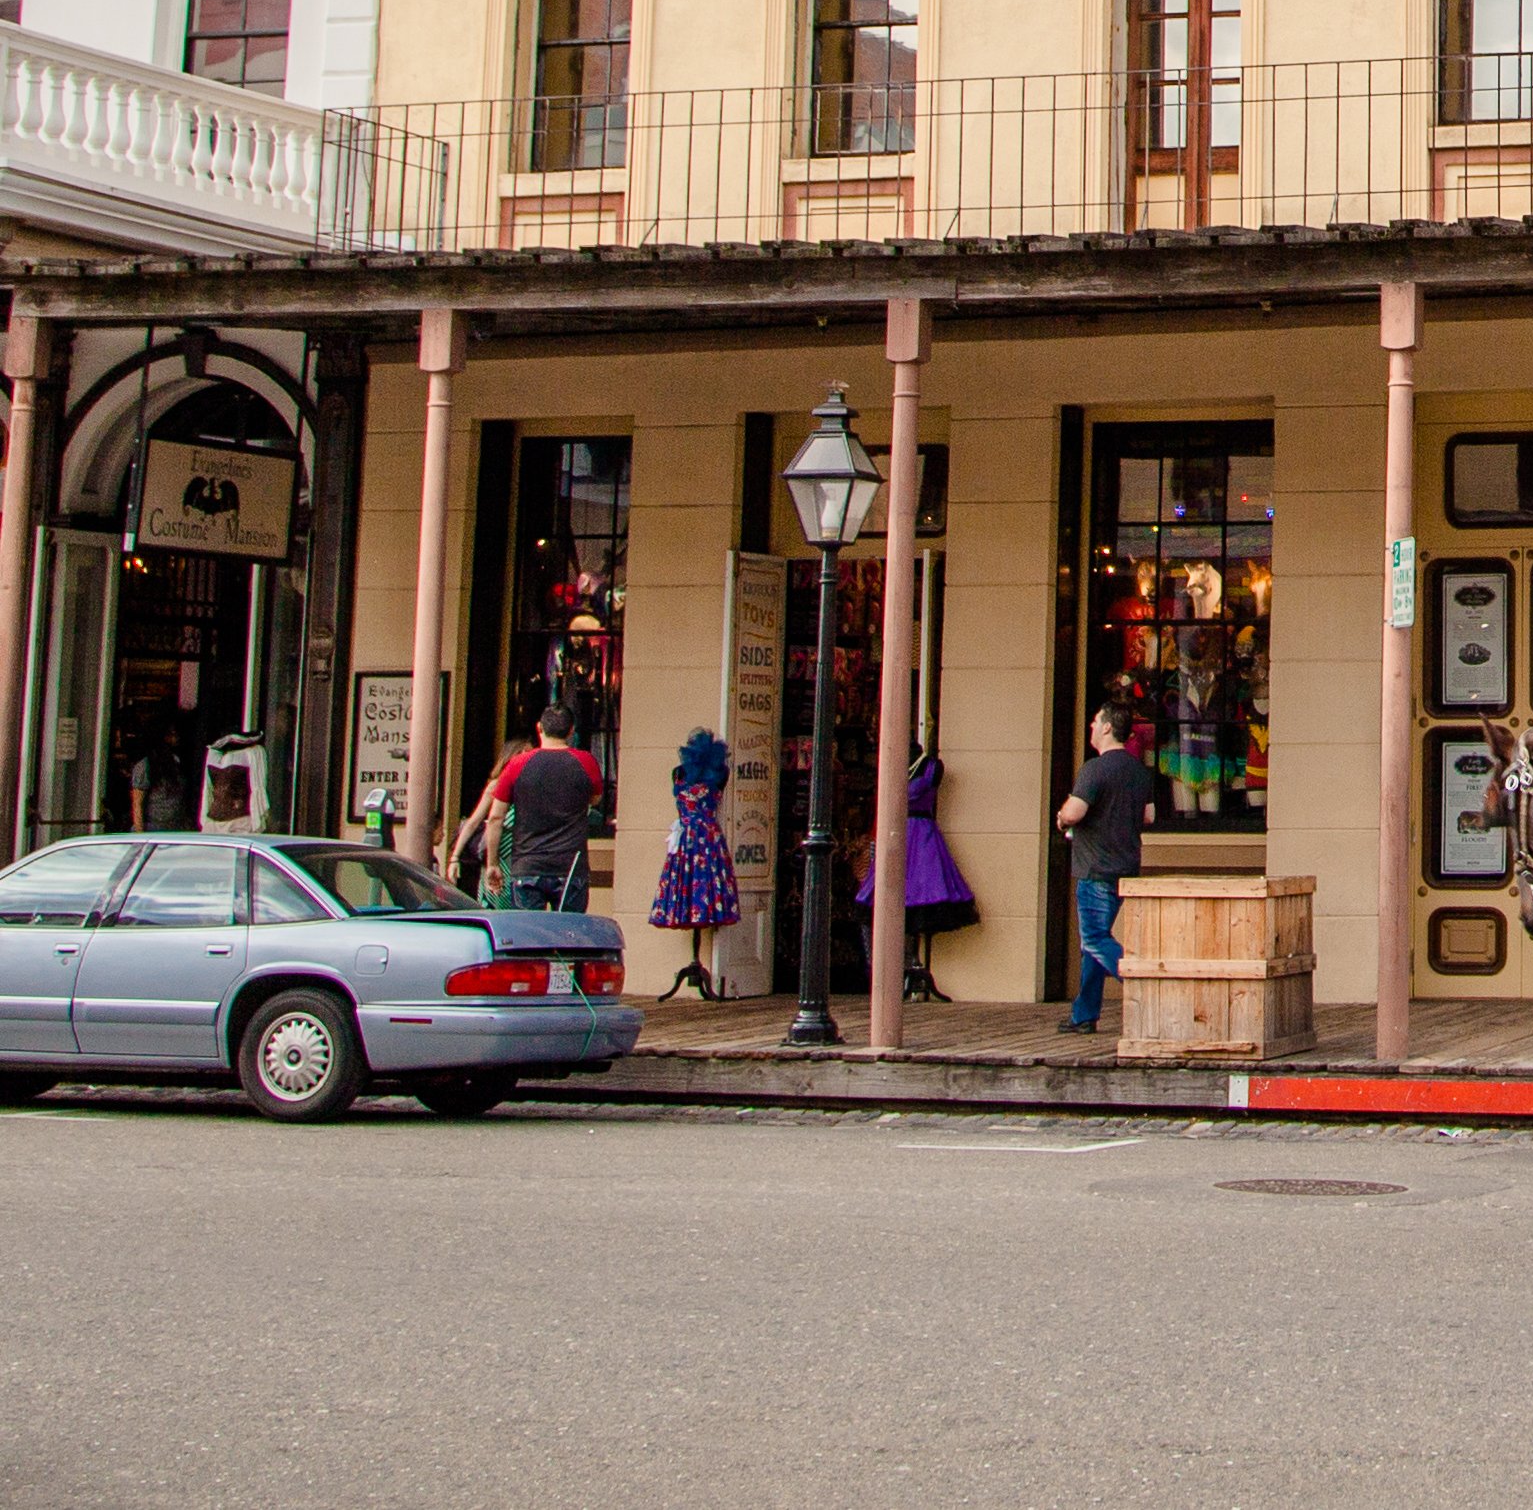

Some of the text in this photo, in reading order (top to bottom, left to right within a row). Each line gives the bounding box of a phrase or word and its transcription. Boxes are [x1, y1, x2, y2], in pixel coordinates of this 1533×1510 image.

[150, 507, 210, 540] Costume
[742, 602, 775, 629] TOYS
[739, 645, 774, 667] SIDE
[738, 692, 772, 712] GAGS
[360, 771, 400, 783] ENTER
[736, 761, 770, 781] MAGIC
